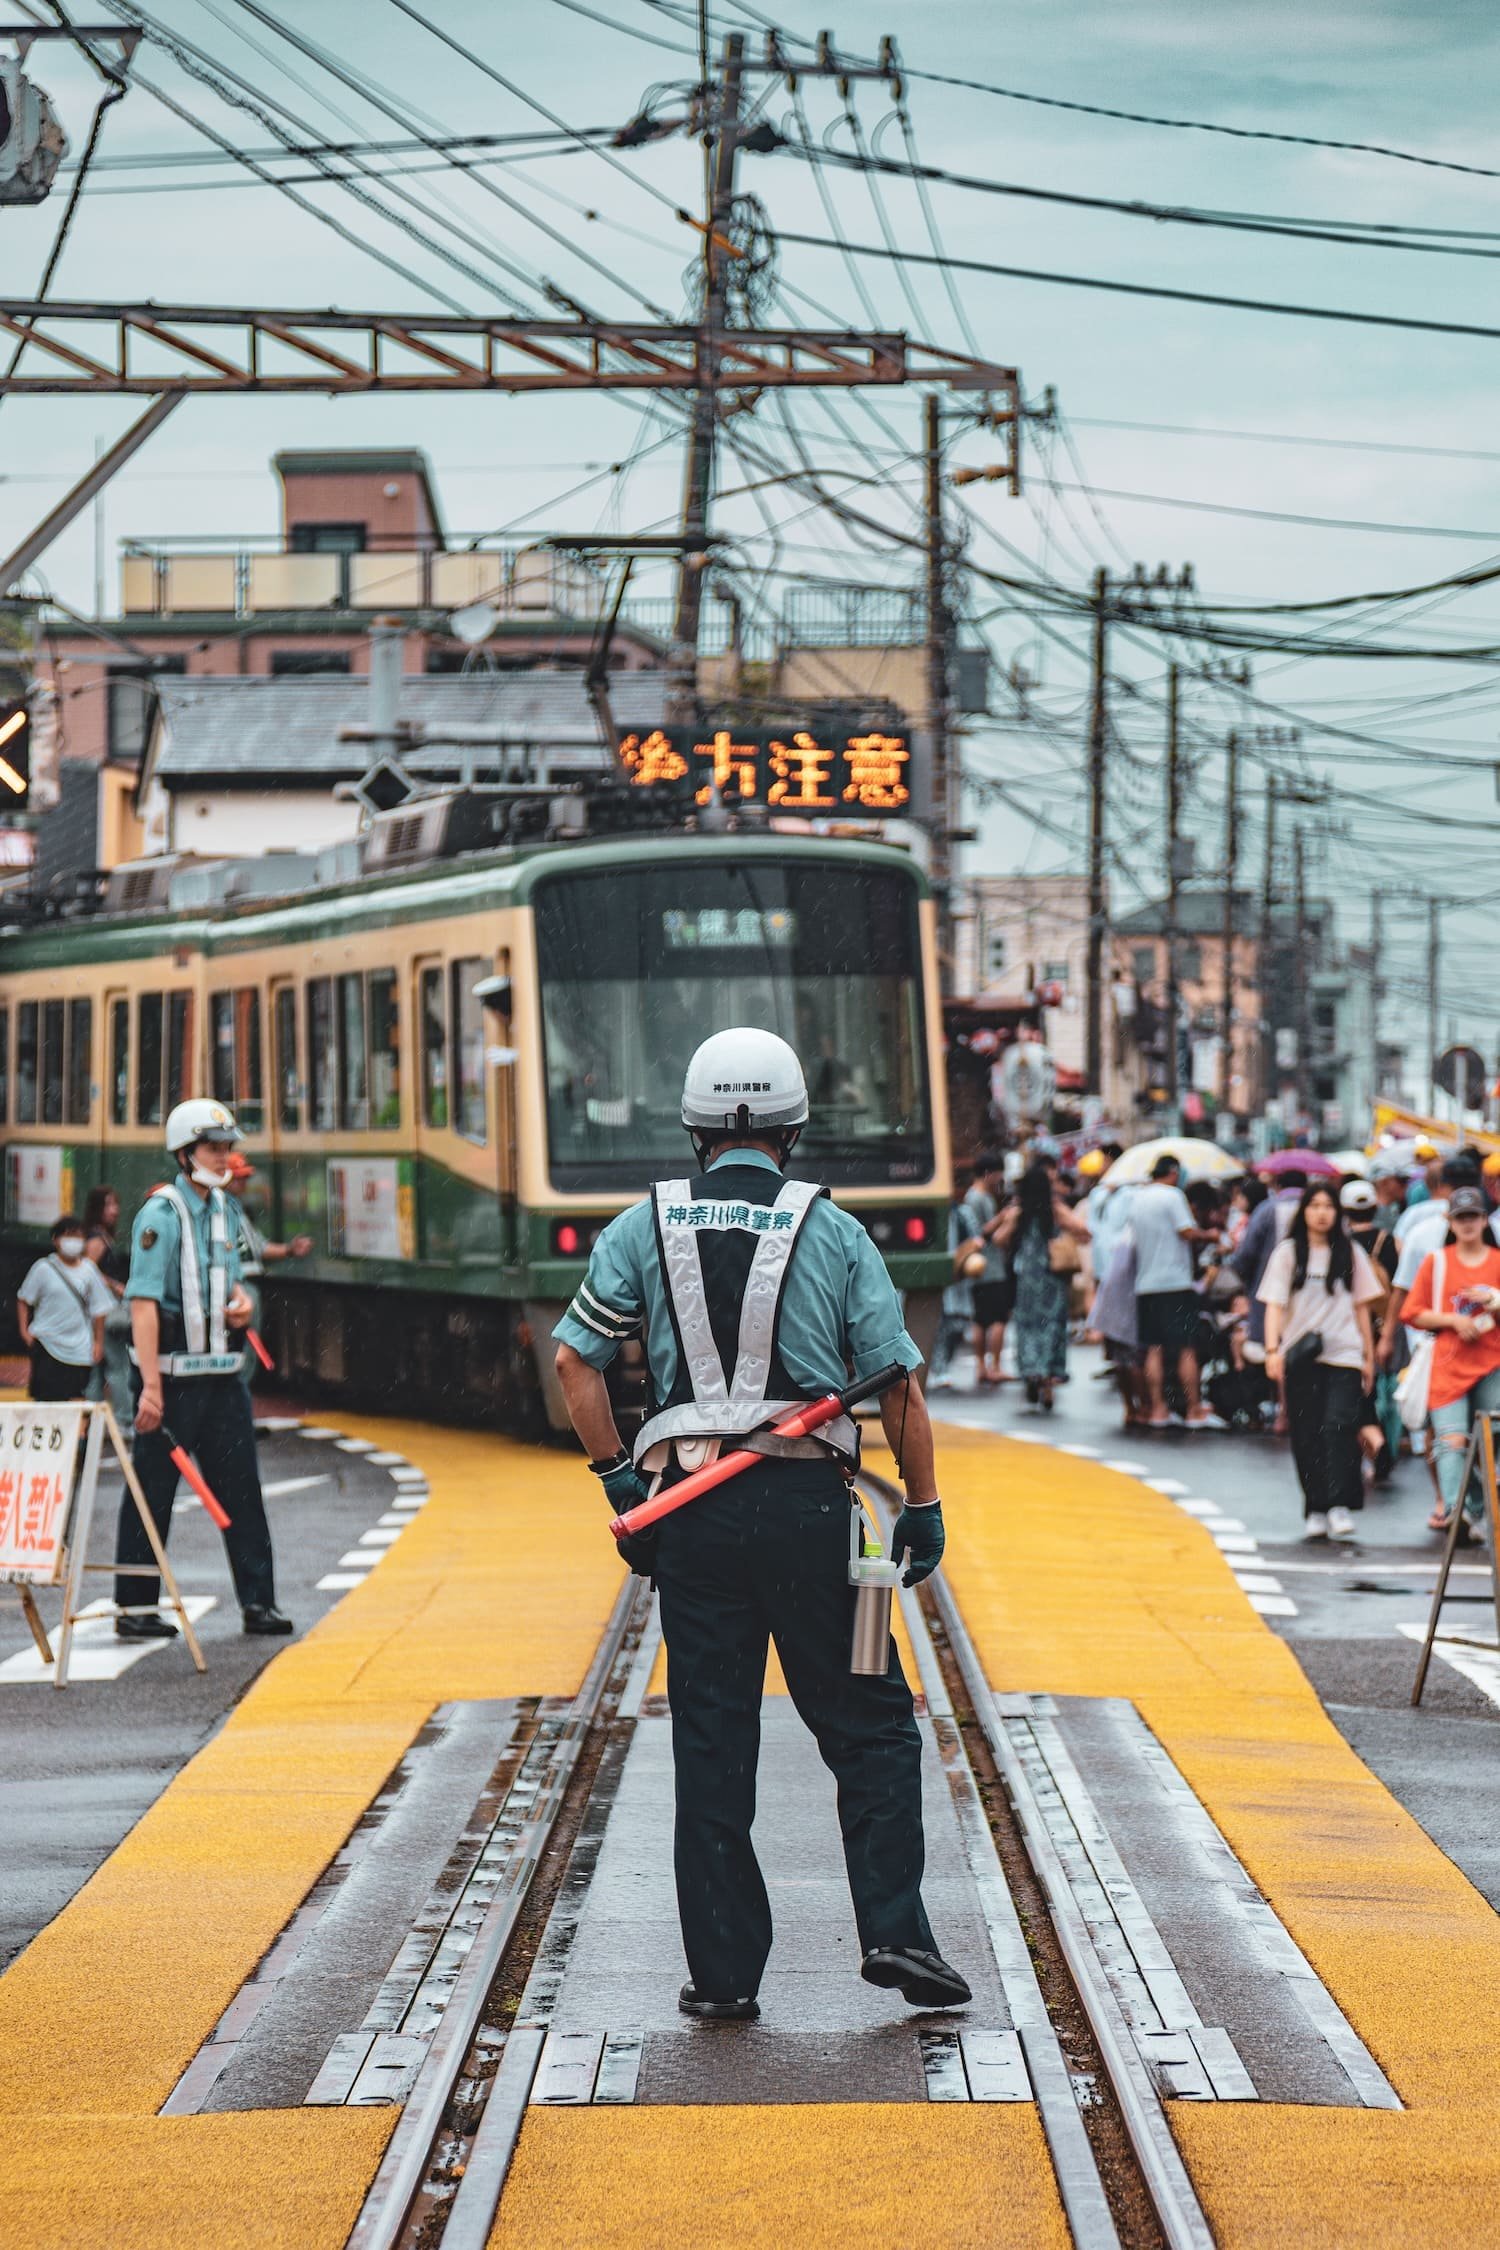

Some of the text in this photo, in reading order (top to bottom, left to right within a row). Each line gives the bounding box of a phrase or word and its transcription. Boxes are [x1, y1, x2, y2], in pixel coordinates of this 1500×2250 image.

[713, 1082, 772, 1093] 神奈川県警察
[665, 1205, 795, 1230] 神奈川県警察
